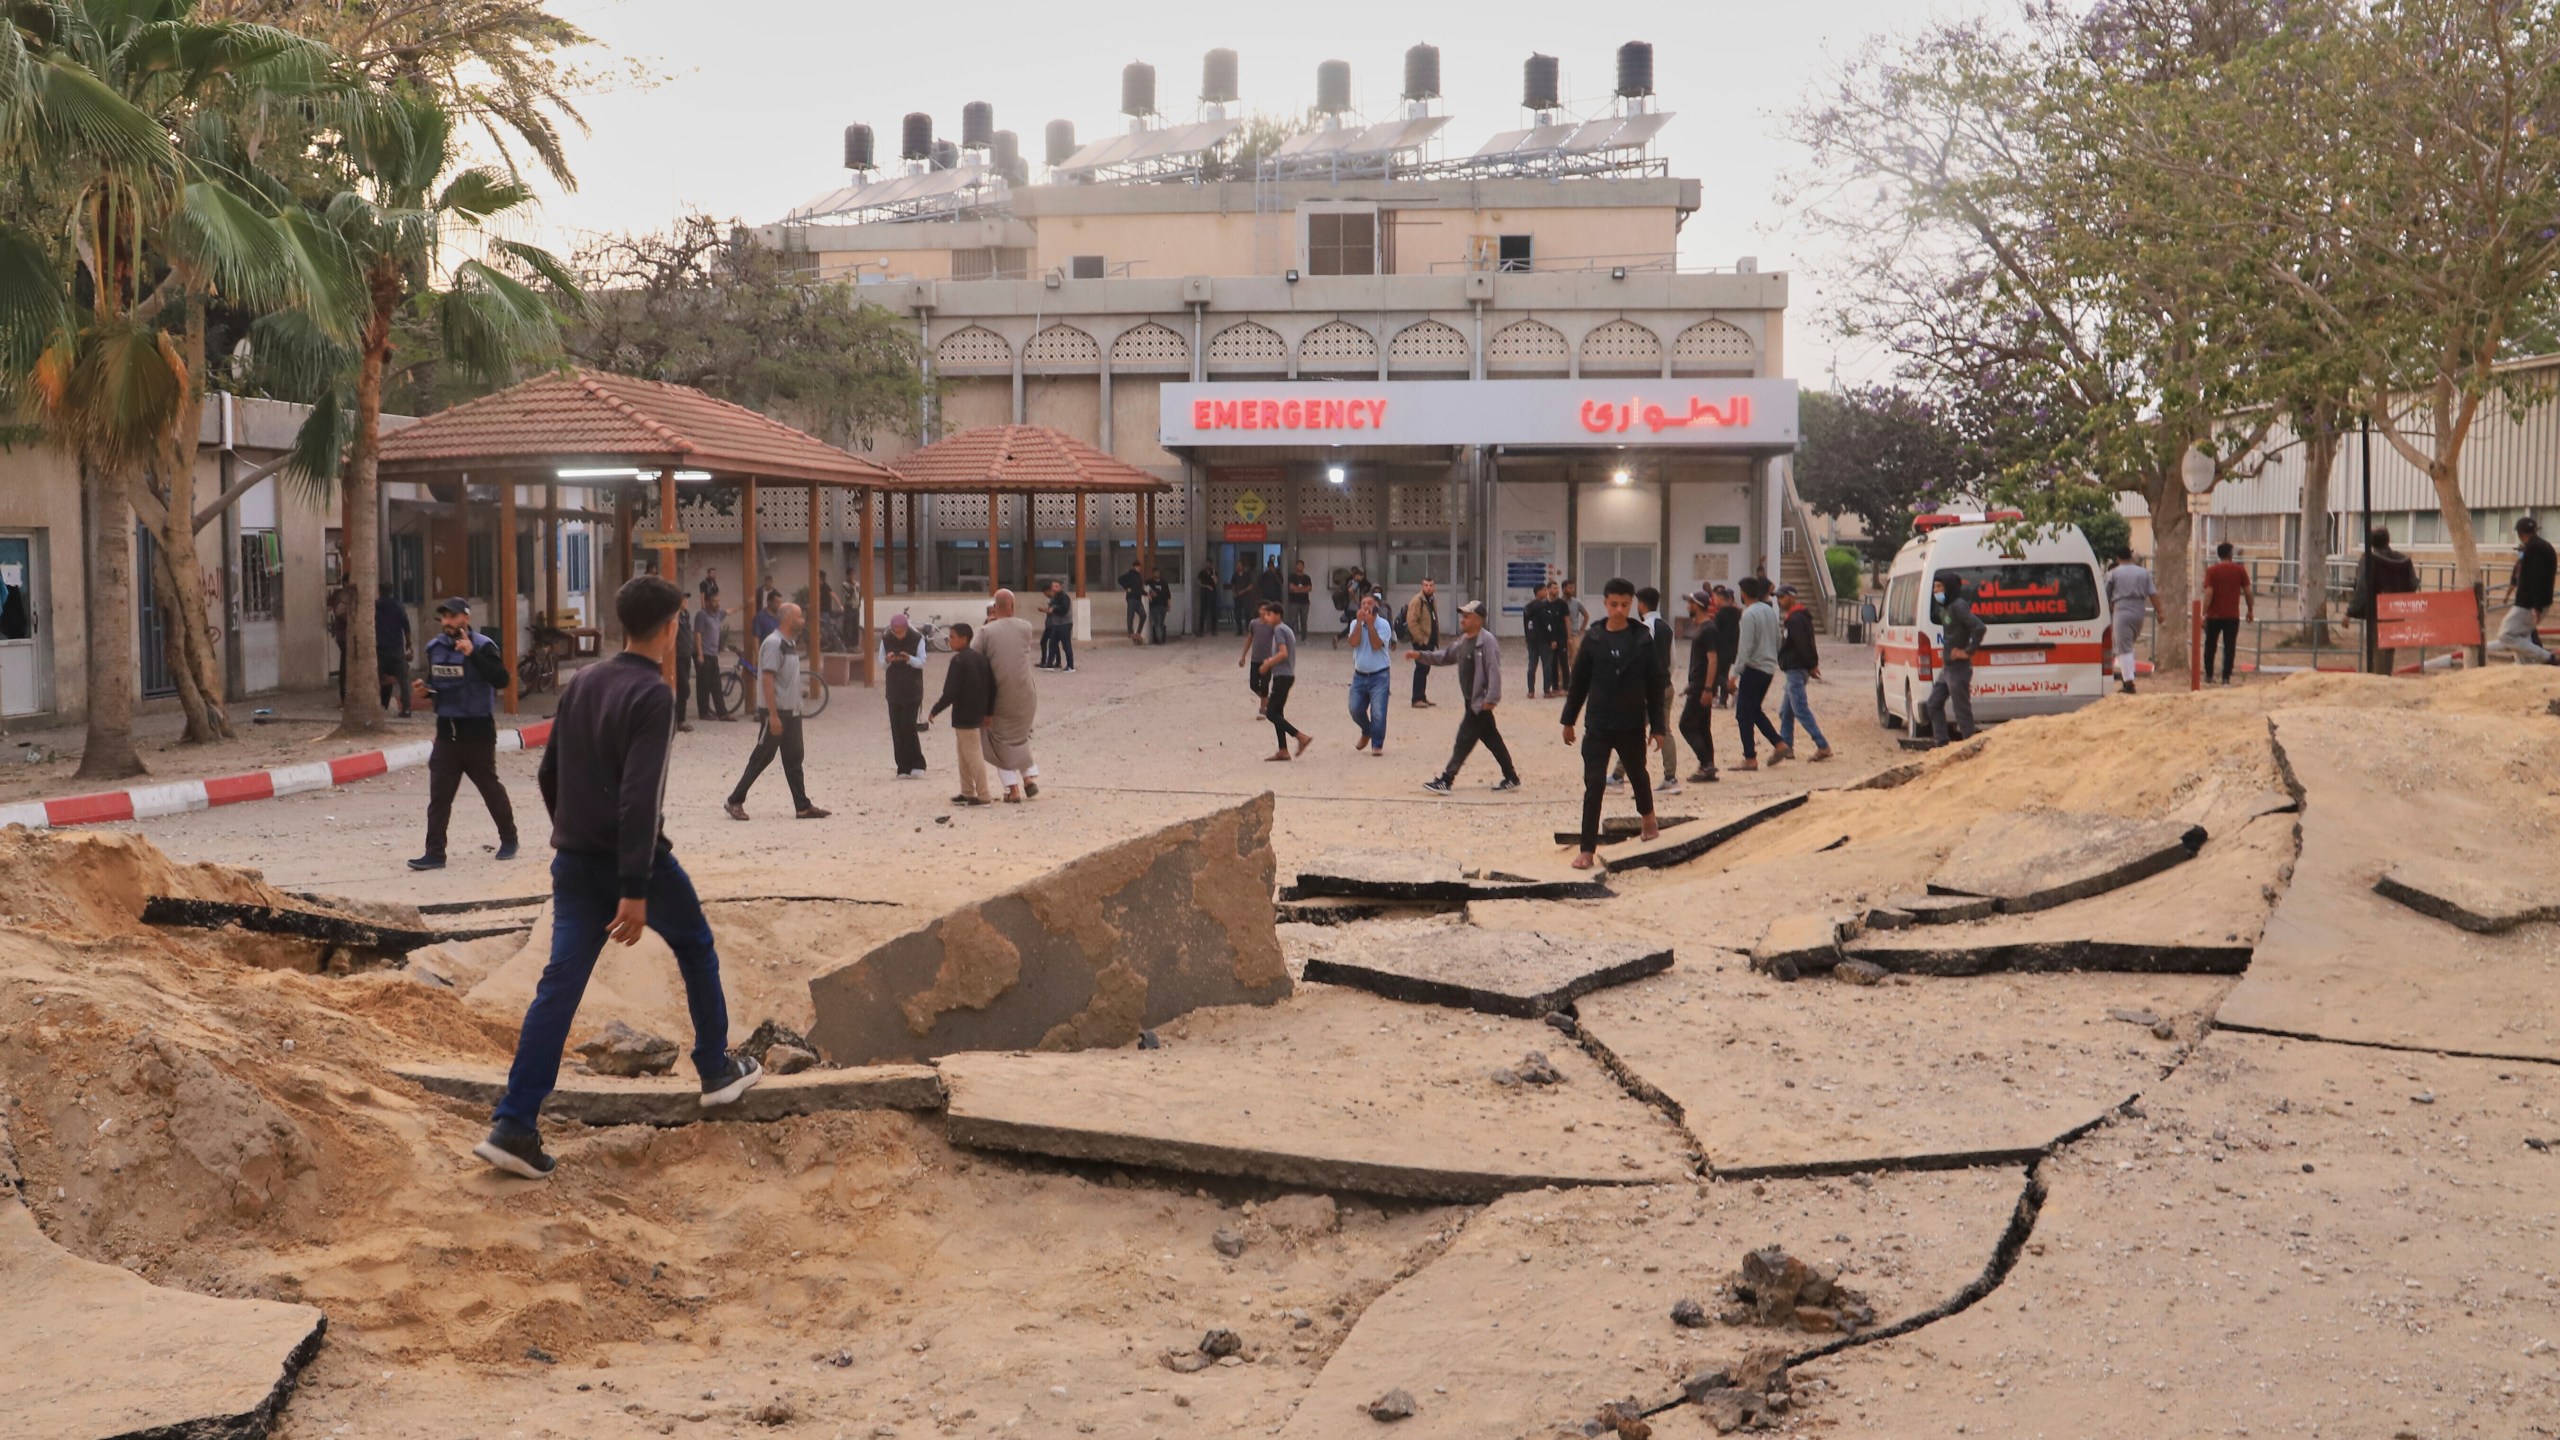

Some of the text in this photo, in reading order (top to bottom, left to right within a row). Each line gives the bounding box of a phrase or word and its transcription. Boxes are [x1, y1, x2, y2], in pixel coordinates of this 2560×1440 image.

[1194, 400, 1387, 430] EMERGENCY
[1582, 397, 1750, 433] الطوارئ
[1970, 600, 2067, 615] AMBULANCE
[2038, 625, 2091, 638] وزارة الصحة
